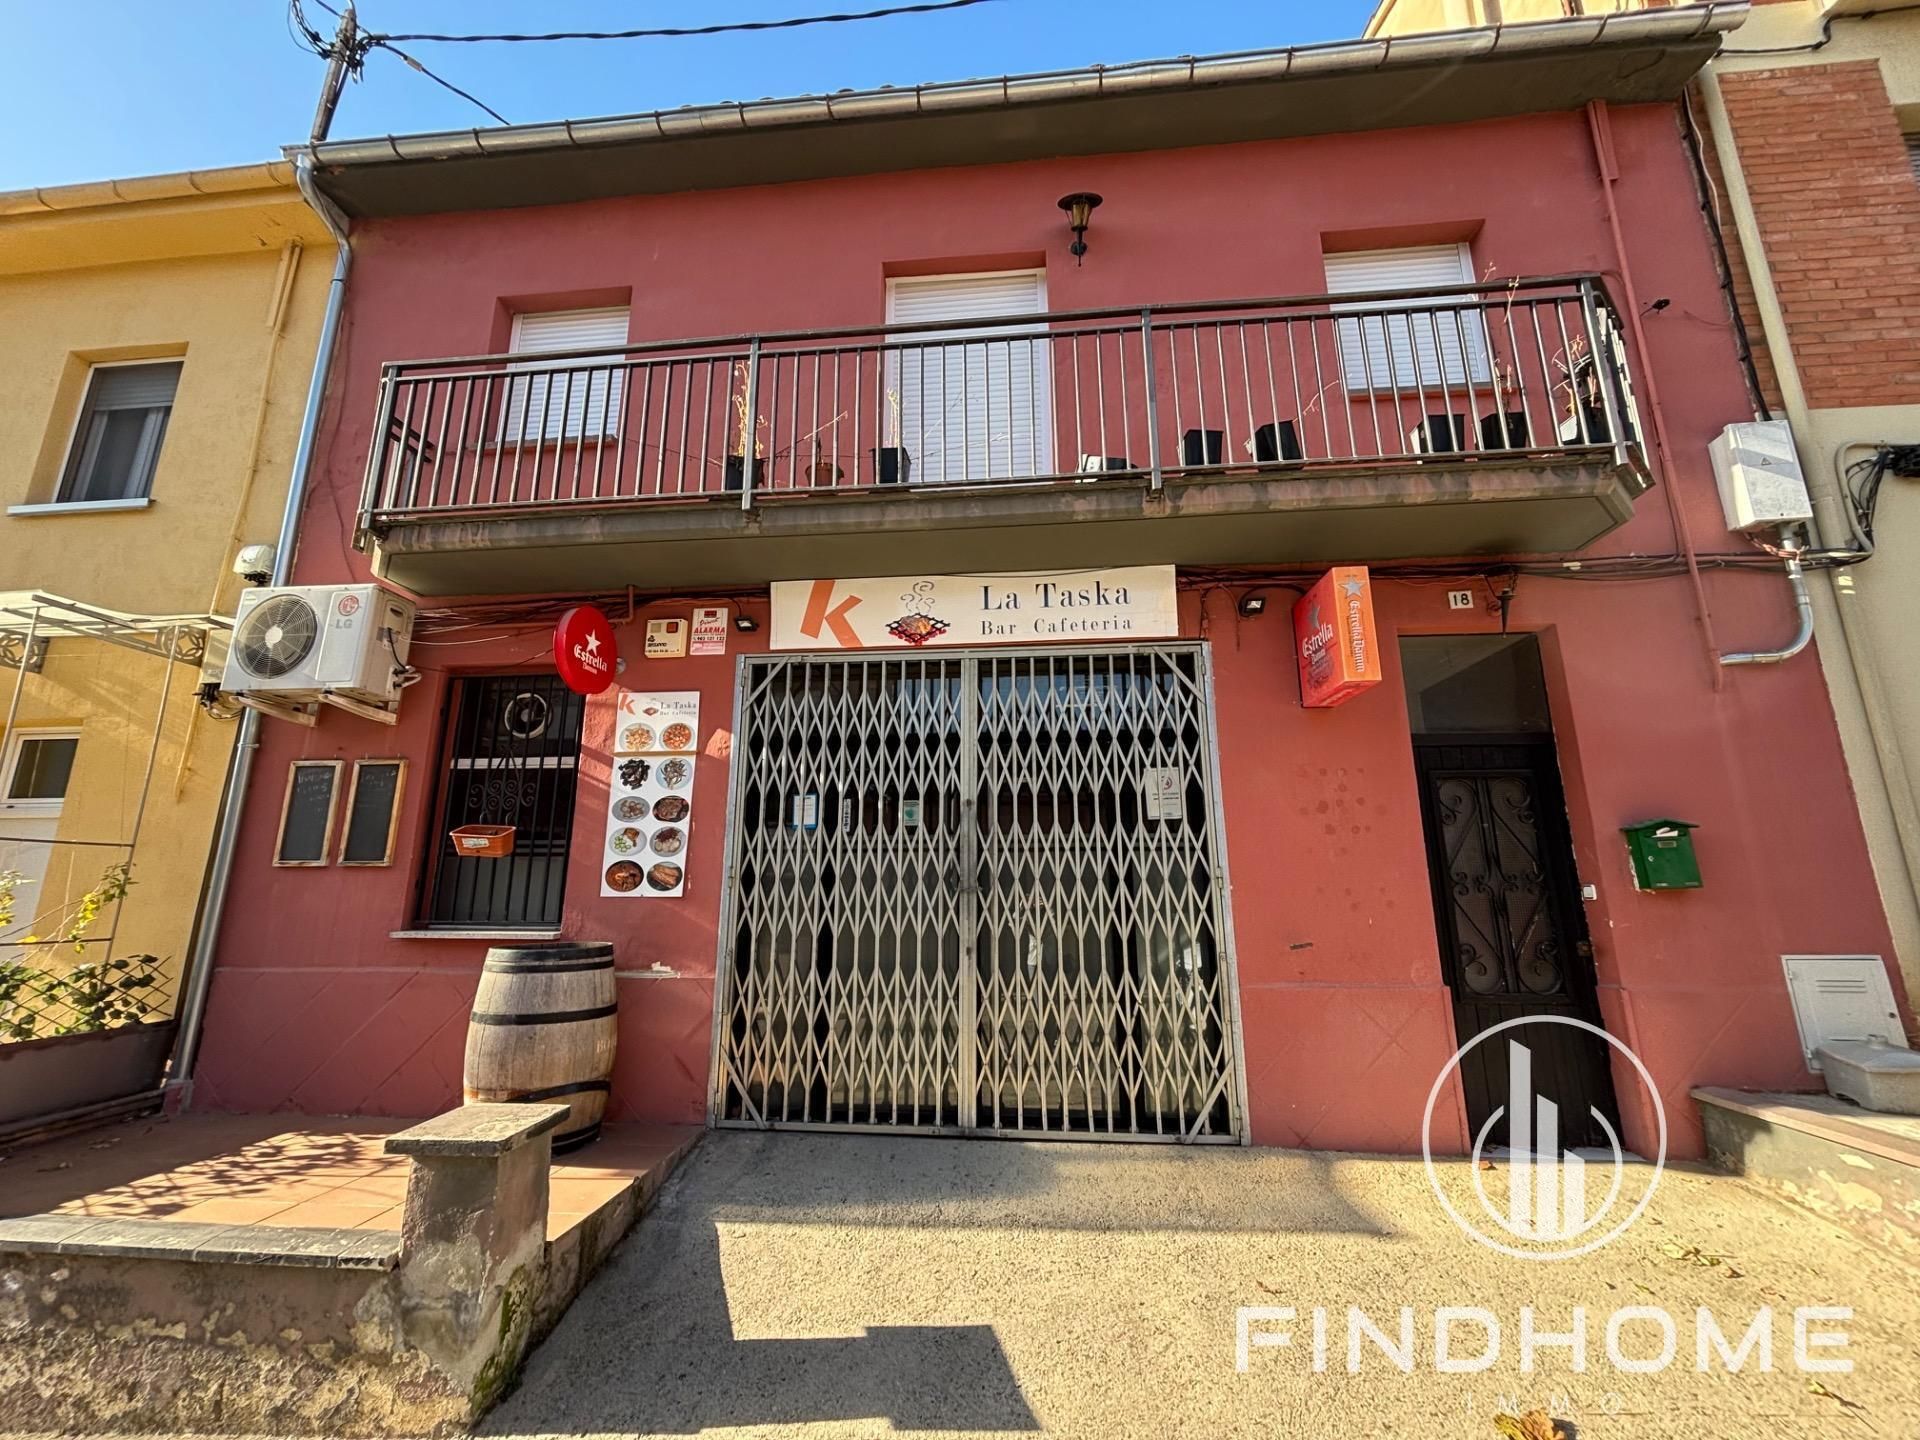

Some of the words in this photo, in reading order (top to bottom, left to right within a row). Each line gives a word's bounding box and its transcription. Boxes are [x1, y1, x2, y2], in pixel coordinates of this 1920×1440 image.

[979, 584, 1021, 610] La
[1035, 580, 1131, 608] Taska
[1453, 593, 1470, 606] 18
[335, 618, 353, 630] LG
[693, 626, 725, 634] ALARMA
[981, 619, 1017, 635] Bar
[1033, 614, 1132, 634] Cafeteria
[1349, 600, 1363, 639] Estrella
[1302, 622, 1334, 658] Estrella
[573, 643, 608, 672] Estrella
[673, 700, 697, 710] Taska
